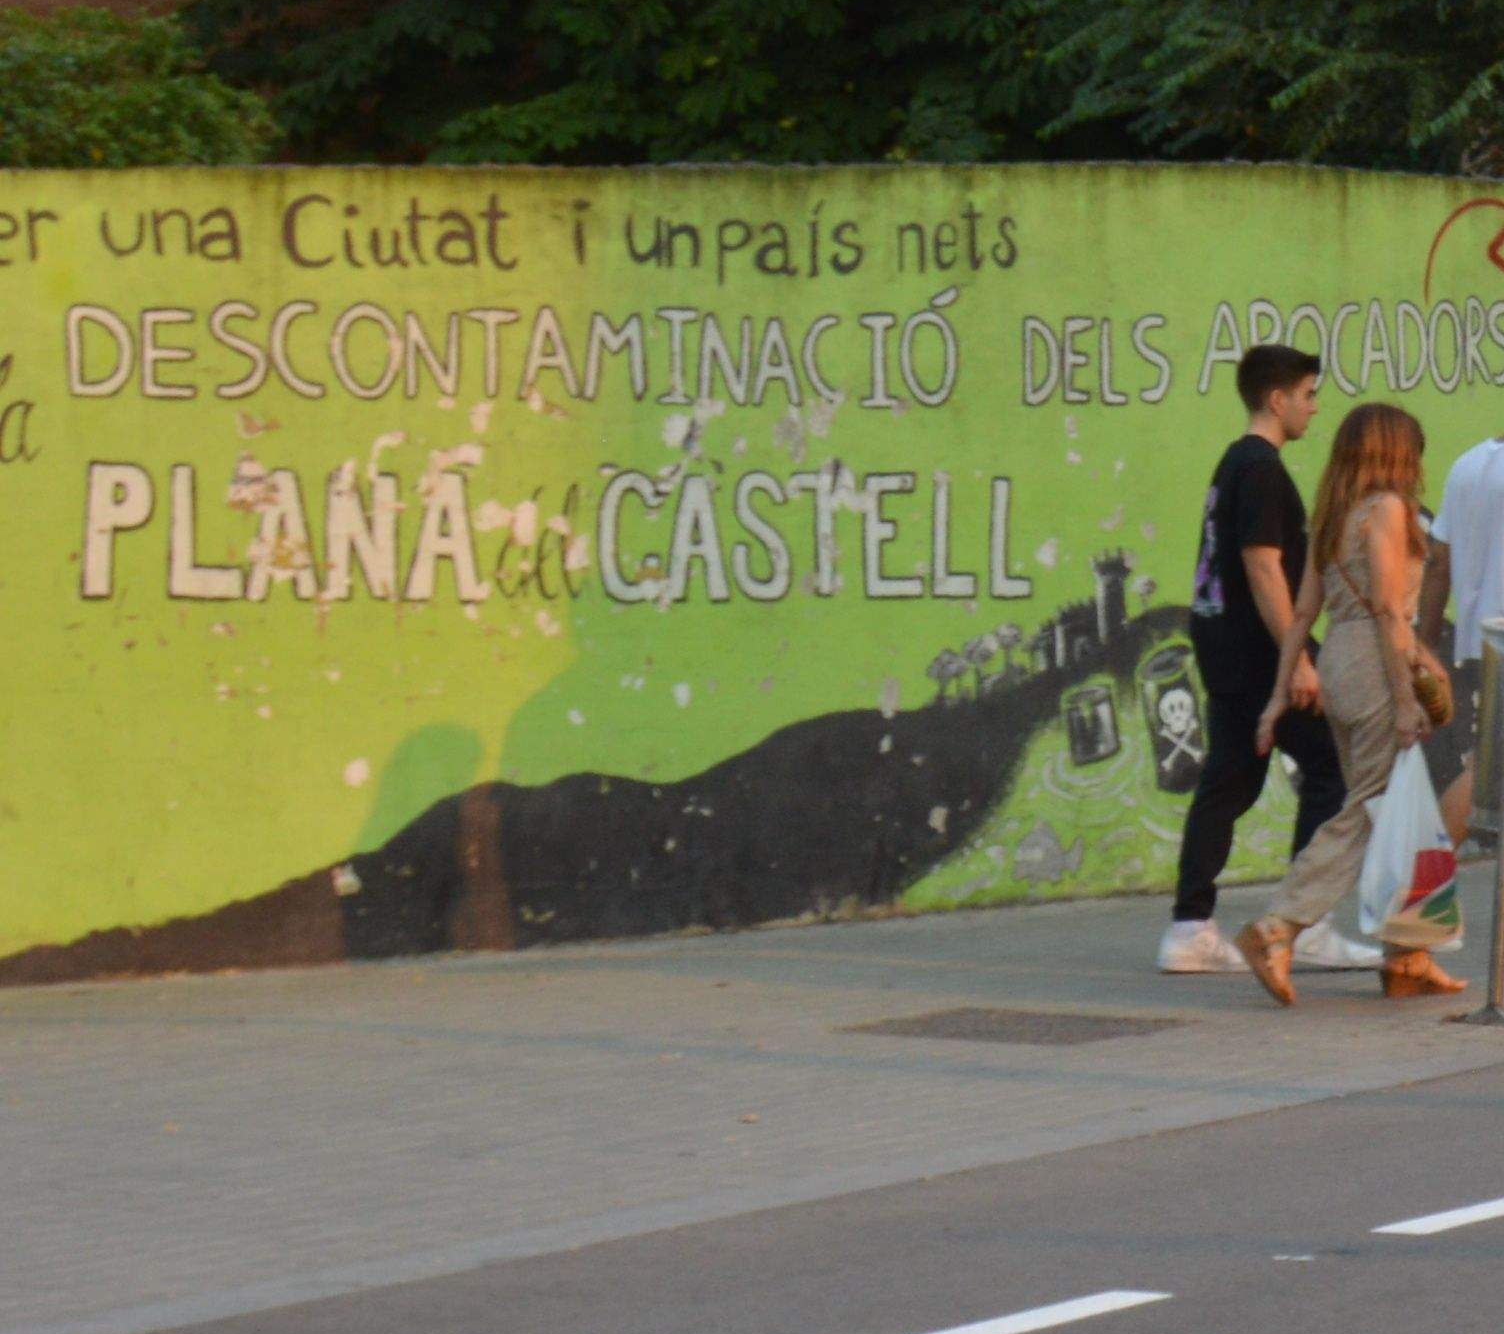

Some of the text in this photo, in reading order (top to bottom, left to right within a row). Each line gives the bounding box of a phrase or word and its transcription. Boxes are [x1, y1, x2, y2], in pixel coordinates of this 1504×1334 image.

[100, 205, 242, 263] una
[280, 192, 520, 272] Ciutat
[571, 197, 592, 267] i
[716, 197, 866, 287] país
[896, 200, 1019, 272] nets
[64, 285, 961, 409] DESCONTAMINACIÓ
[1021, 313, 1173, 407] DELS
[79, 460, 482, 604] PLANA
[597, 467, 1033, 604] CASTELL
